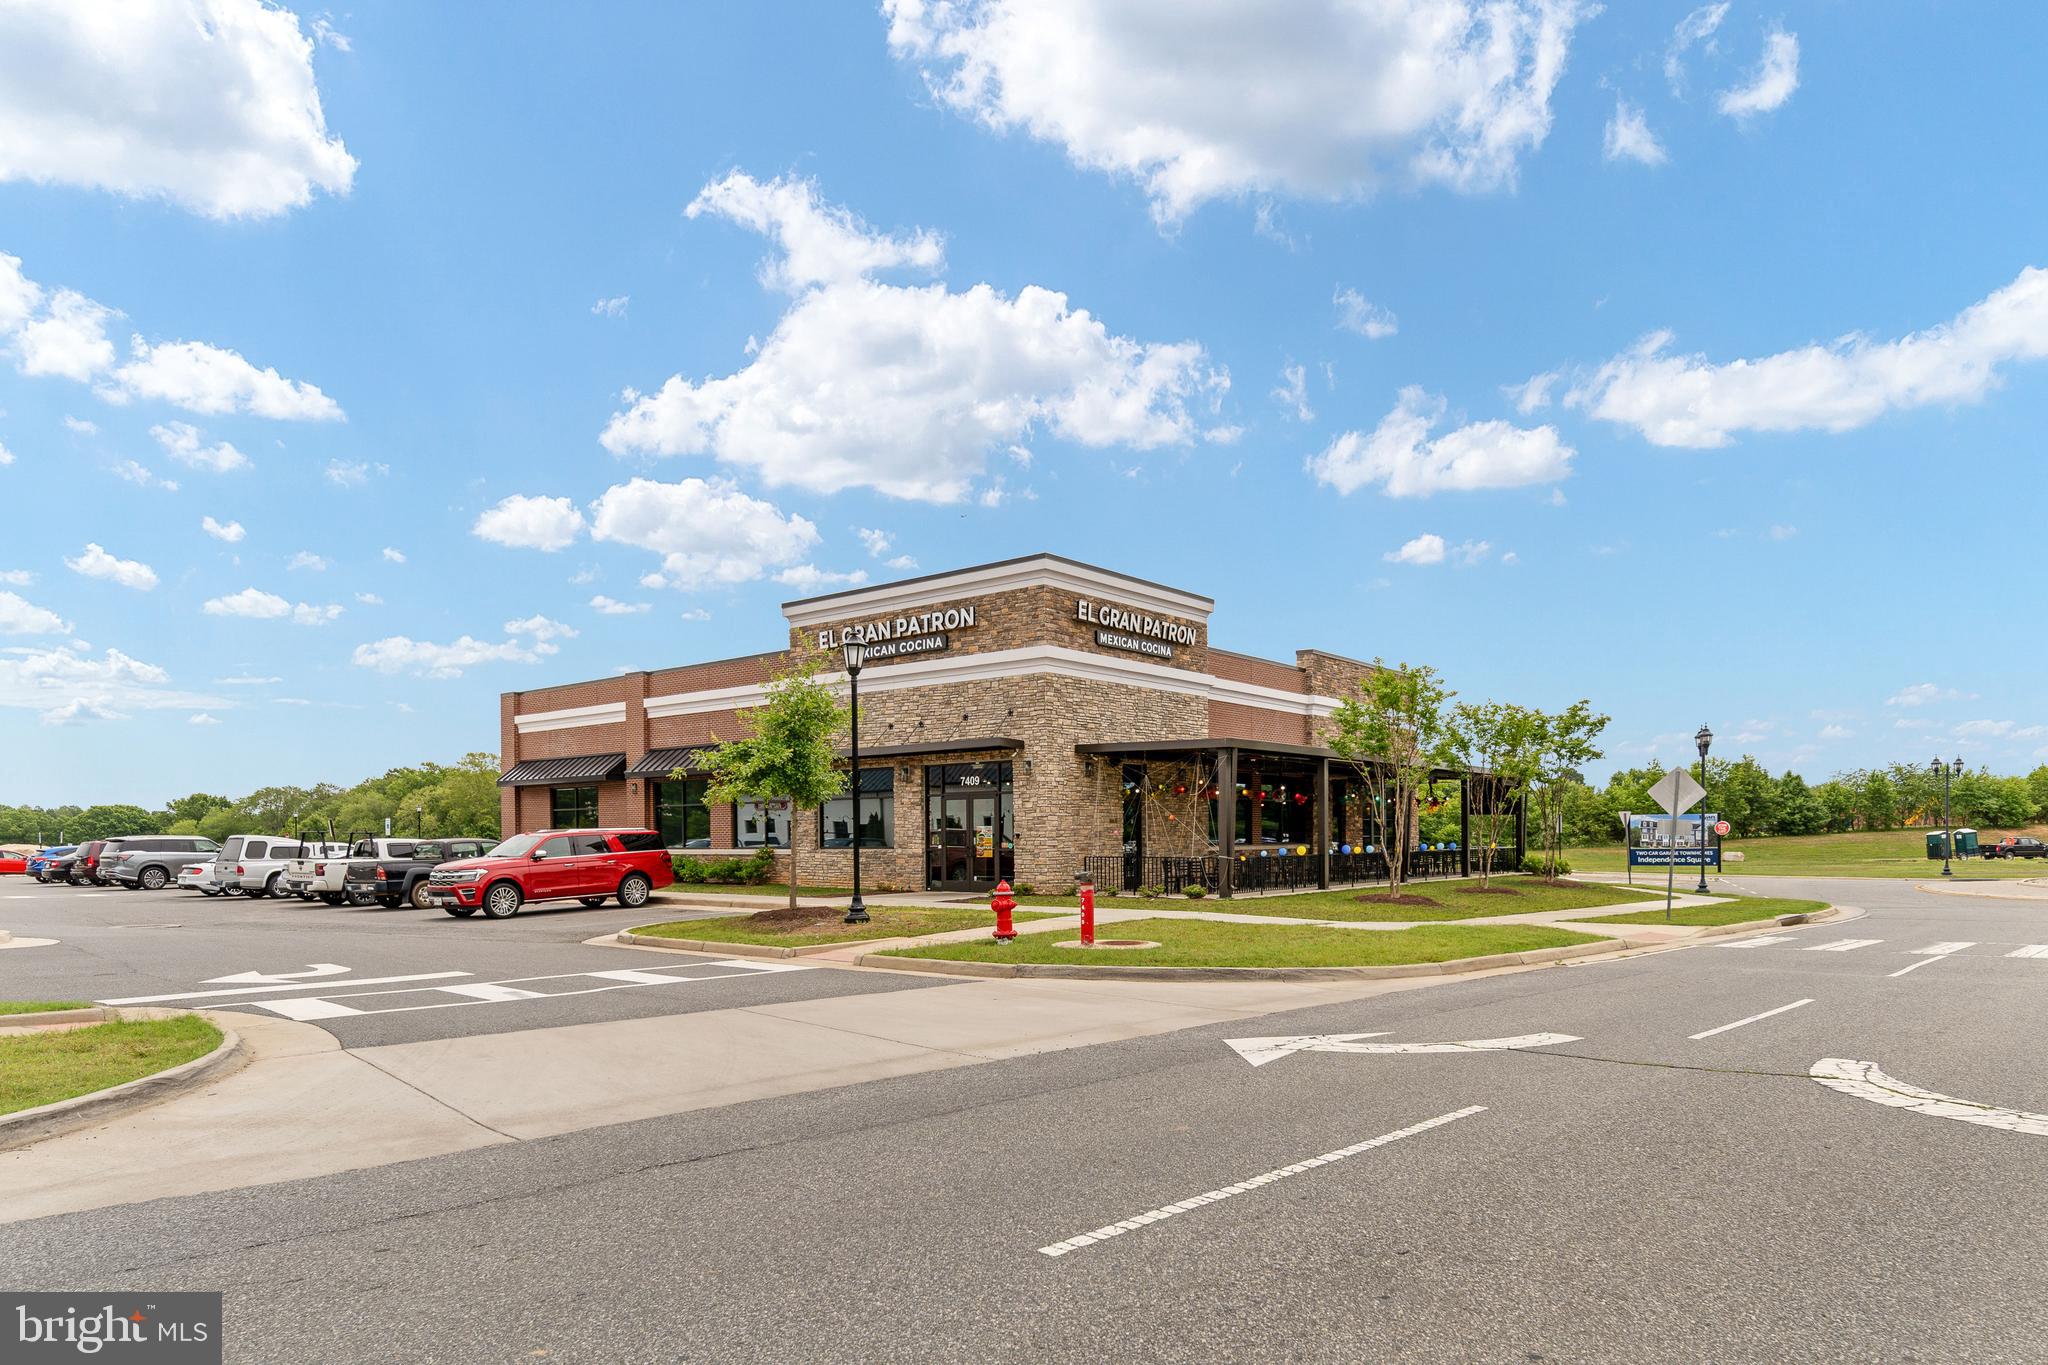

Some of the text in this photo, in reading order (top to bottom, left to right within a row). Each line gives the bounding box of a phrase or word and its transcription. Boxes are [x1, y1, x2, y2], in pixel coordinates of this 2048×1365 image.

[818, 606, 975, 649] EL GRAN PATRON
[1078, 599, 1197, 646] EL GRAN PATRON
[864, 636, 943, 659] XICAN COCINA
[1100, 632, 1172, 657] MEXICAN COCINA
[960, 775, 980, 786] 7409
[1638, 856, 1711, 864] Independnce Sque
